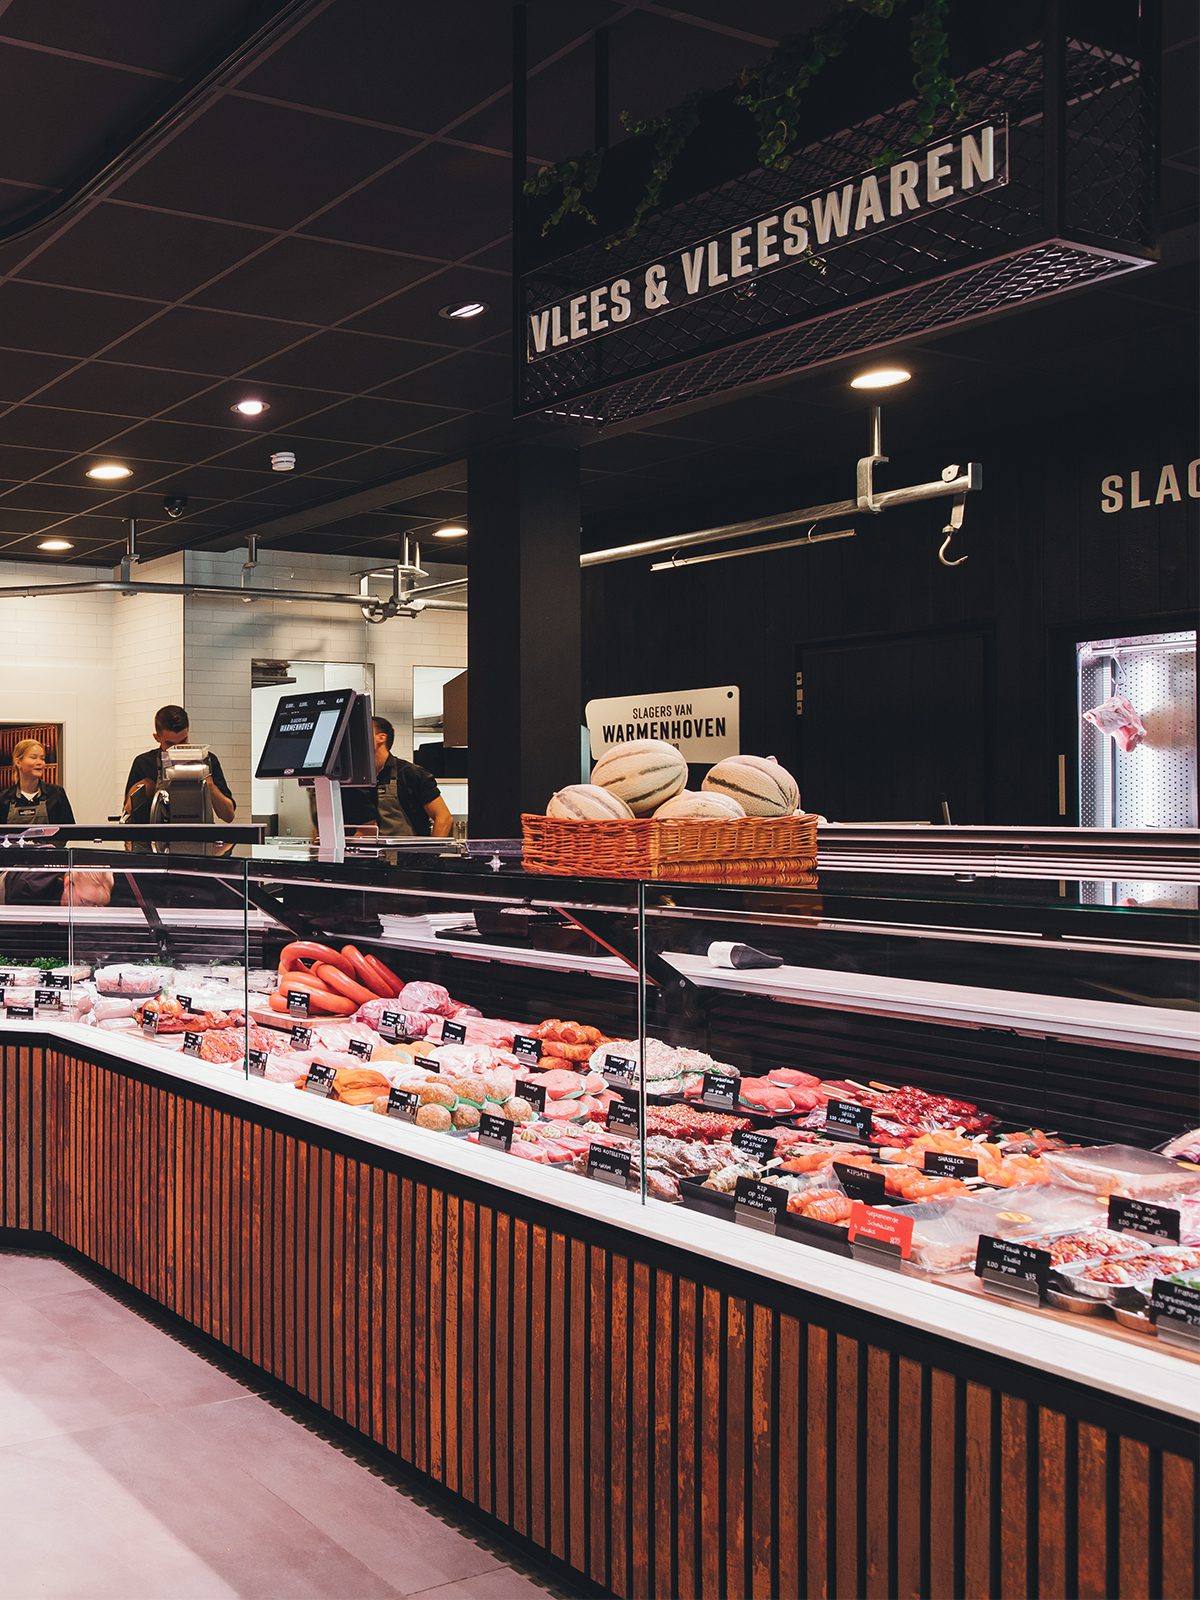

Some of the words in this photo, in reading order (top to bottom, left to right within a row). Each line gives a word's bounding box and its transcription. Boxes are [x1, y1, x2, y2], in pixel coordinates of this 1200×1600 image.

[530, 279, 632, 354] VLEES
[643, 264, 669, 308] &
[681, 126, 995, 295] VLEESWAREN
[632, 705, 672, 720] SLAGERS
[674, 703, 693, 716] VAN
[602, 717, 726, 744] WARMENHOVEN
[756, 1185, 768, 1193] KIP
[747, 1190, 756, 1198] OP
[757, 1194, 773, 1202] STOK
[747, 1199, 764, 1208] GRAM
[1000, 1265, 1017, 1274] gram
